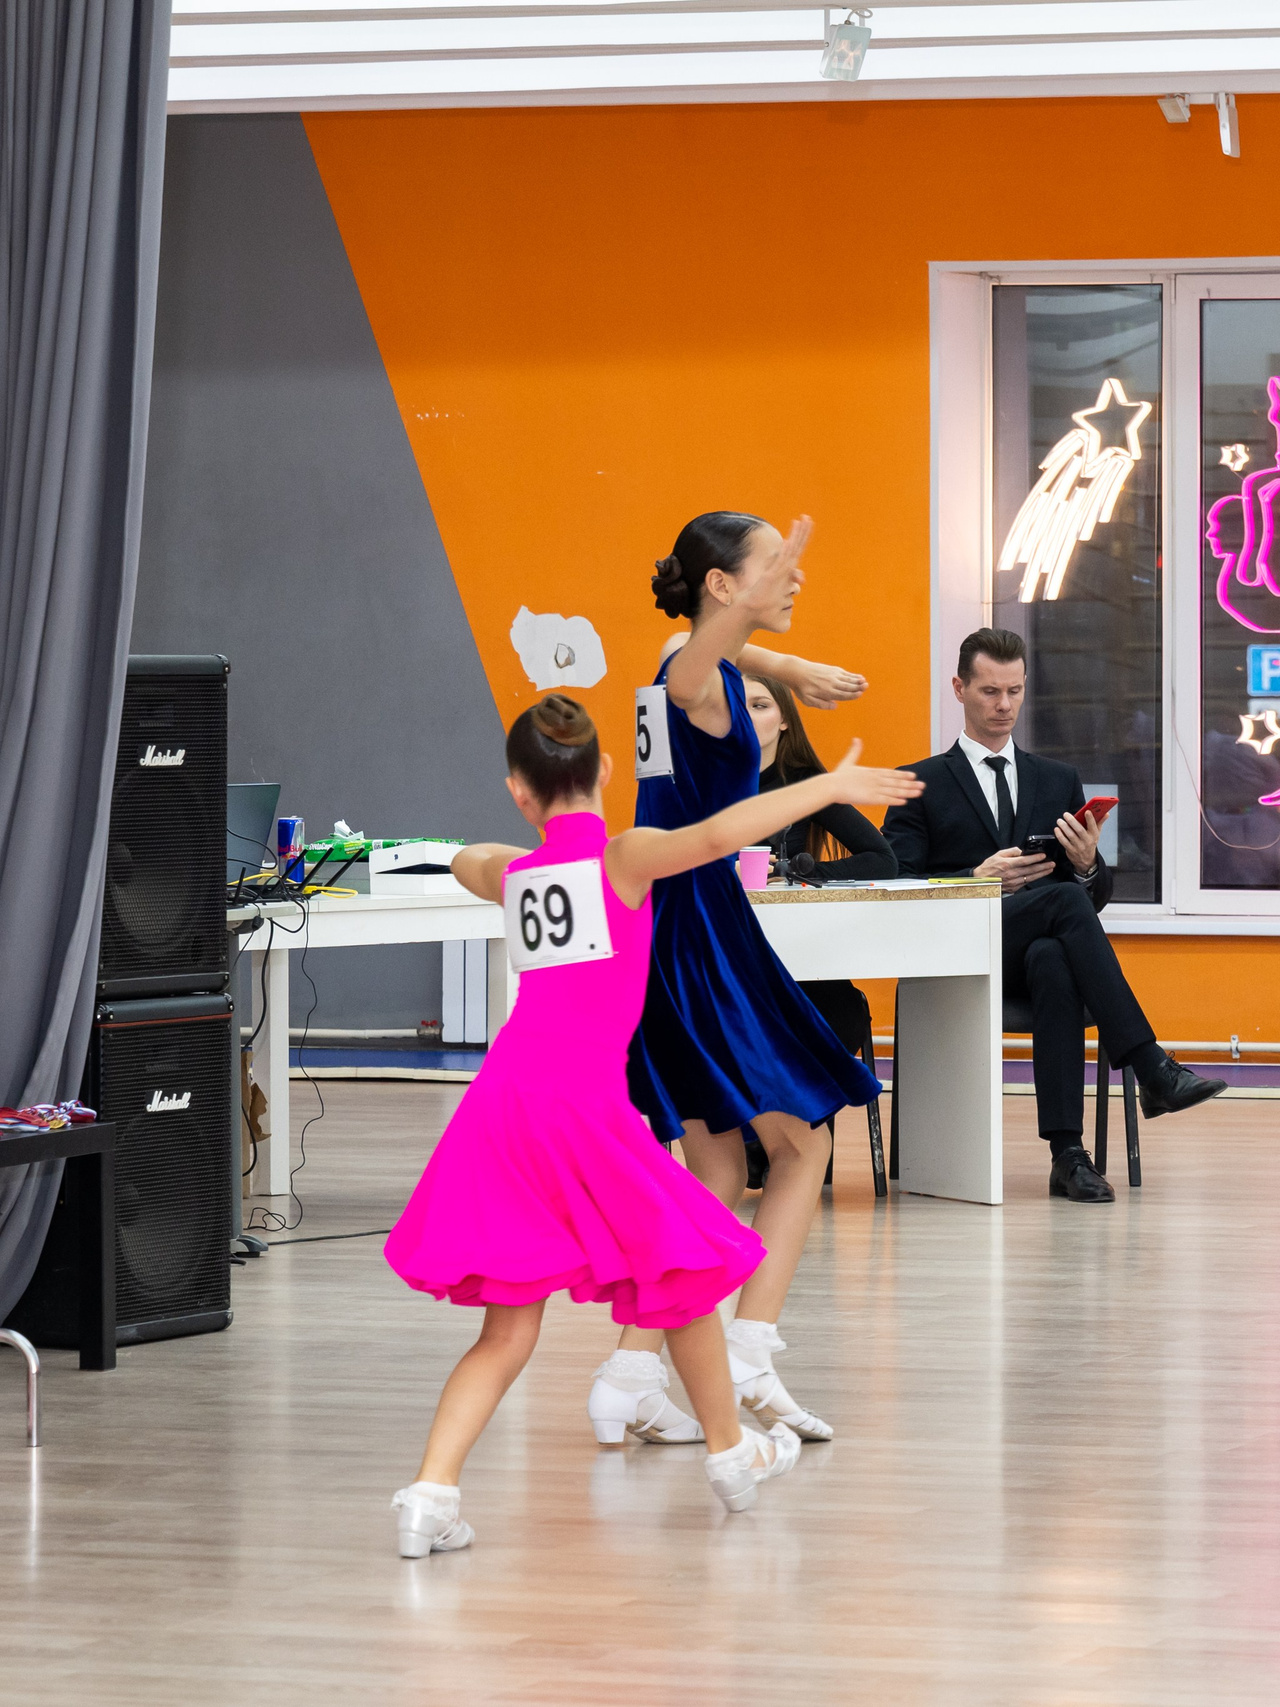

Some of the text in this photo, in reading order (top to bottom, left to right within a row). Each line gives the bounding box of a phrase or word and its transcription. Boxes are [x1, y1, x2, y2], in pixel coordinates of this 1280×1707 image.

[139, 744, 186, 767] Marshall
[519, 883, 574, 952] 69
[146, 1090, 191, 1112] Marshall
